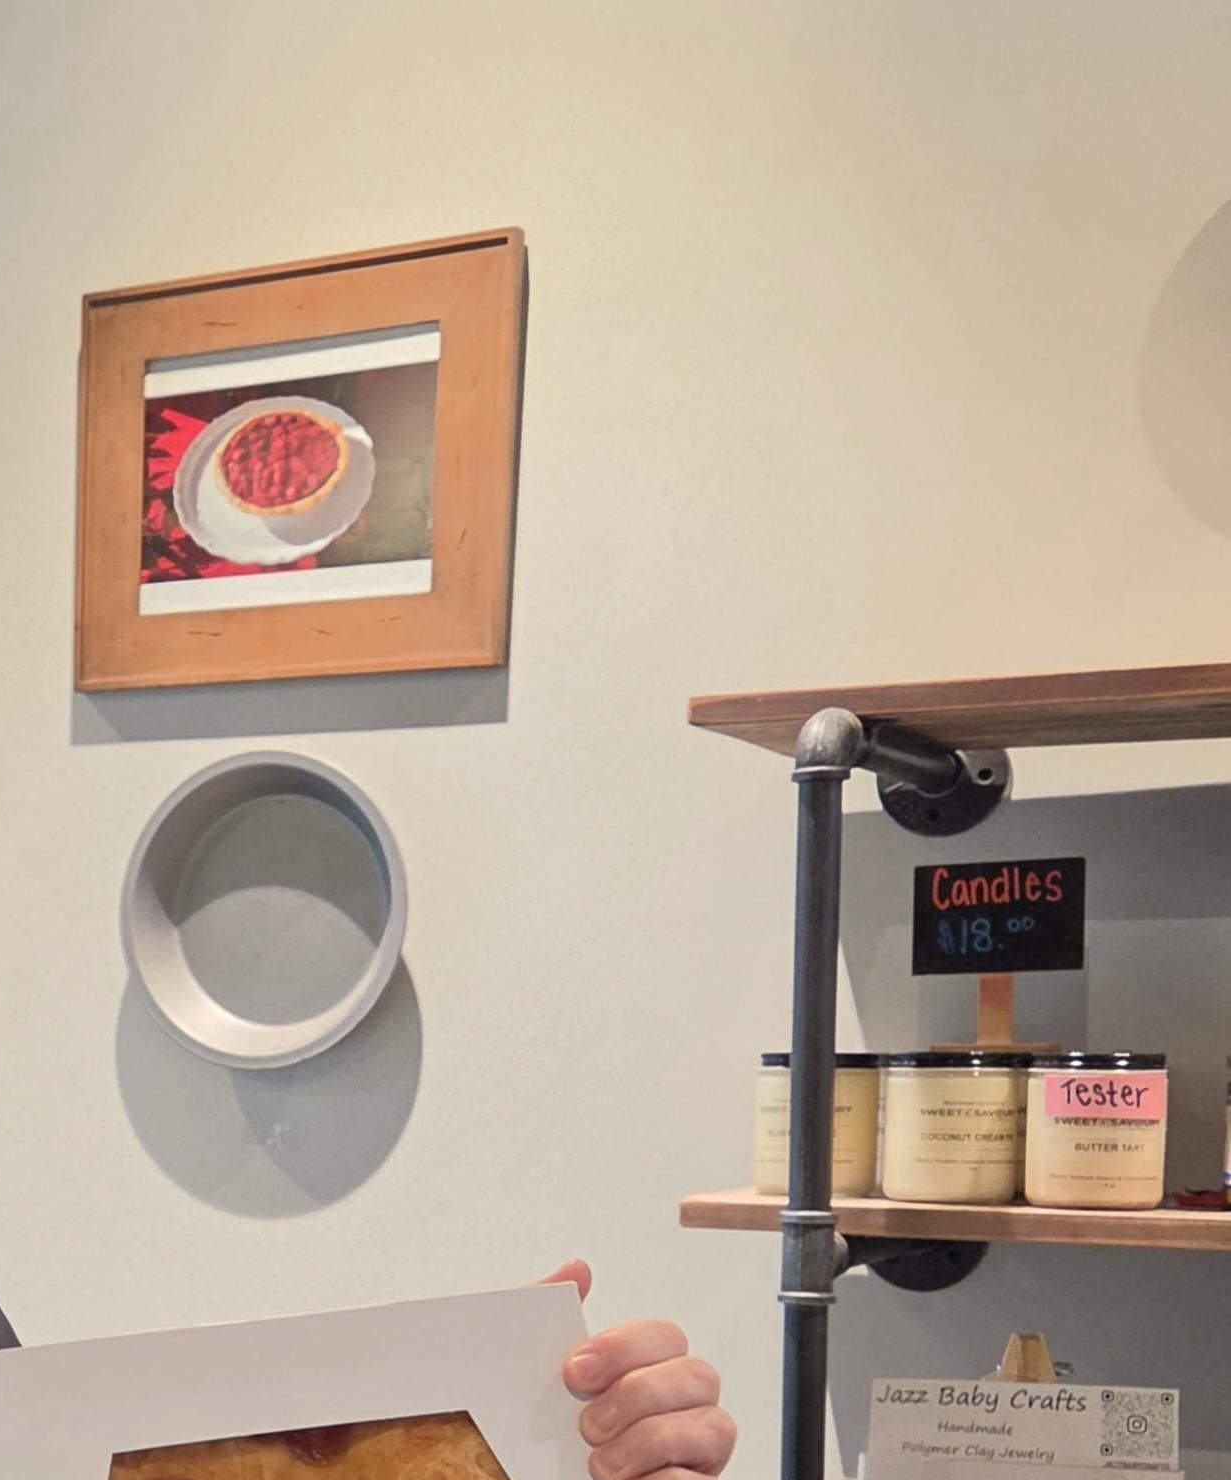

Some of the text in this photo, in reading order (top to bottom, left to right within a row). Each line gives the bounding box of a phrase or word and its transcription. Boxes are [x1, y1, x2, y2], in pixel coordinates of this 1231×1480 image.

[932, 865, 1063, 911] Candles
[1060, 1077, 1149, 1108] Tester
[920, 1107, 963, 1117] SWEET
[920, 1132, 971, 1142] COCONUT
[1074, 1143, 1146, 1153] BUTTER TART
[876, 1383, 1088, 1414] Jazz Baby Crafts
[937, 1420, 1014, 1437] Handmade
[902, 1440, 1057, 1463] Polymer Clay Jewelry
